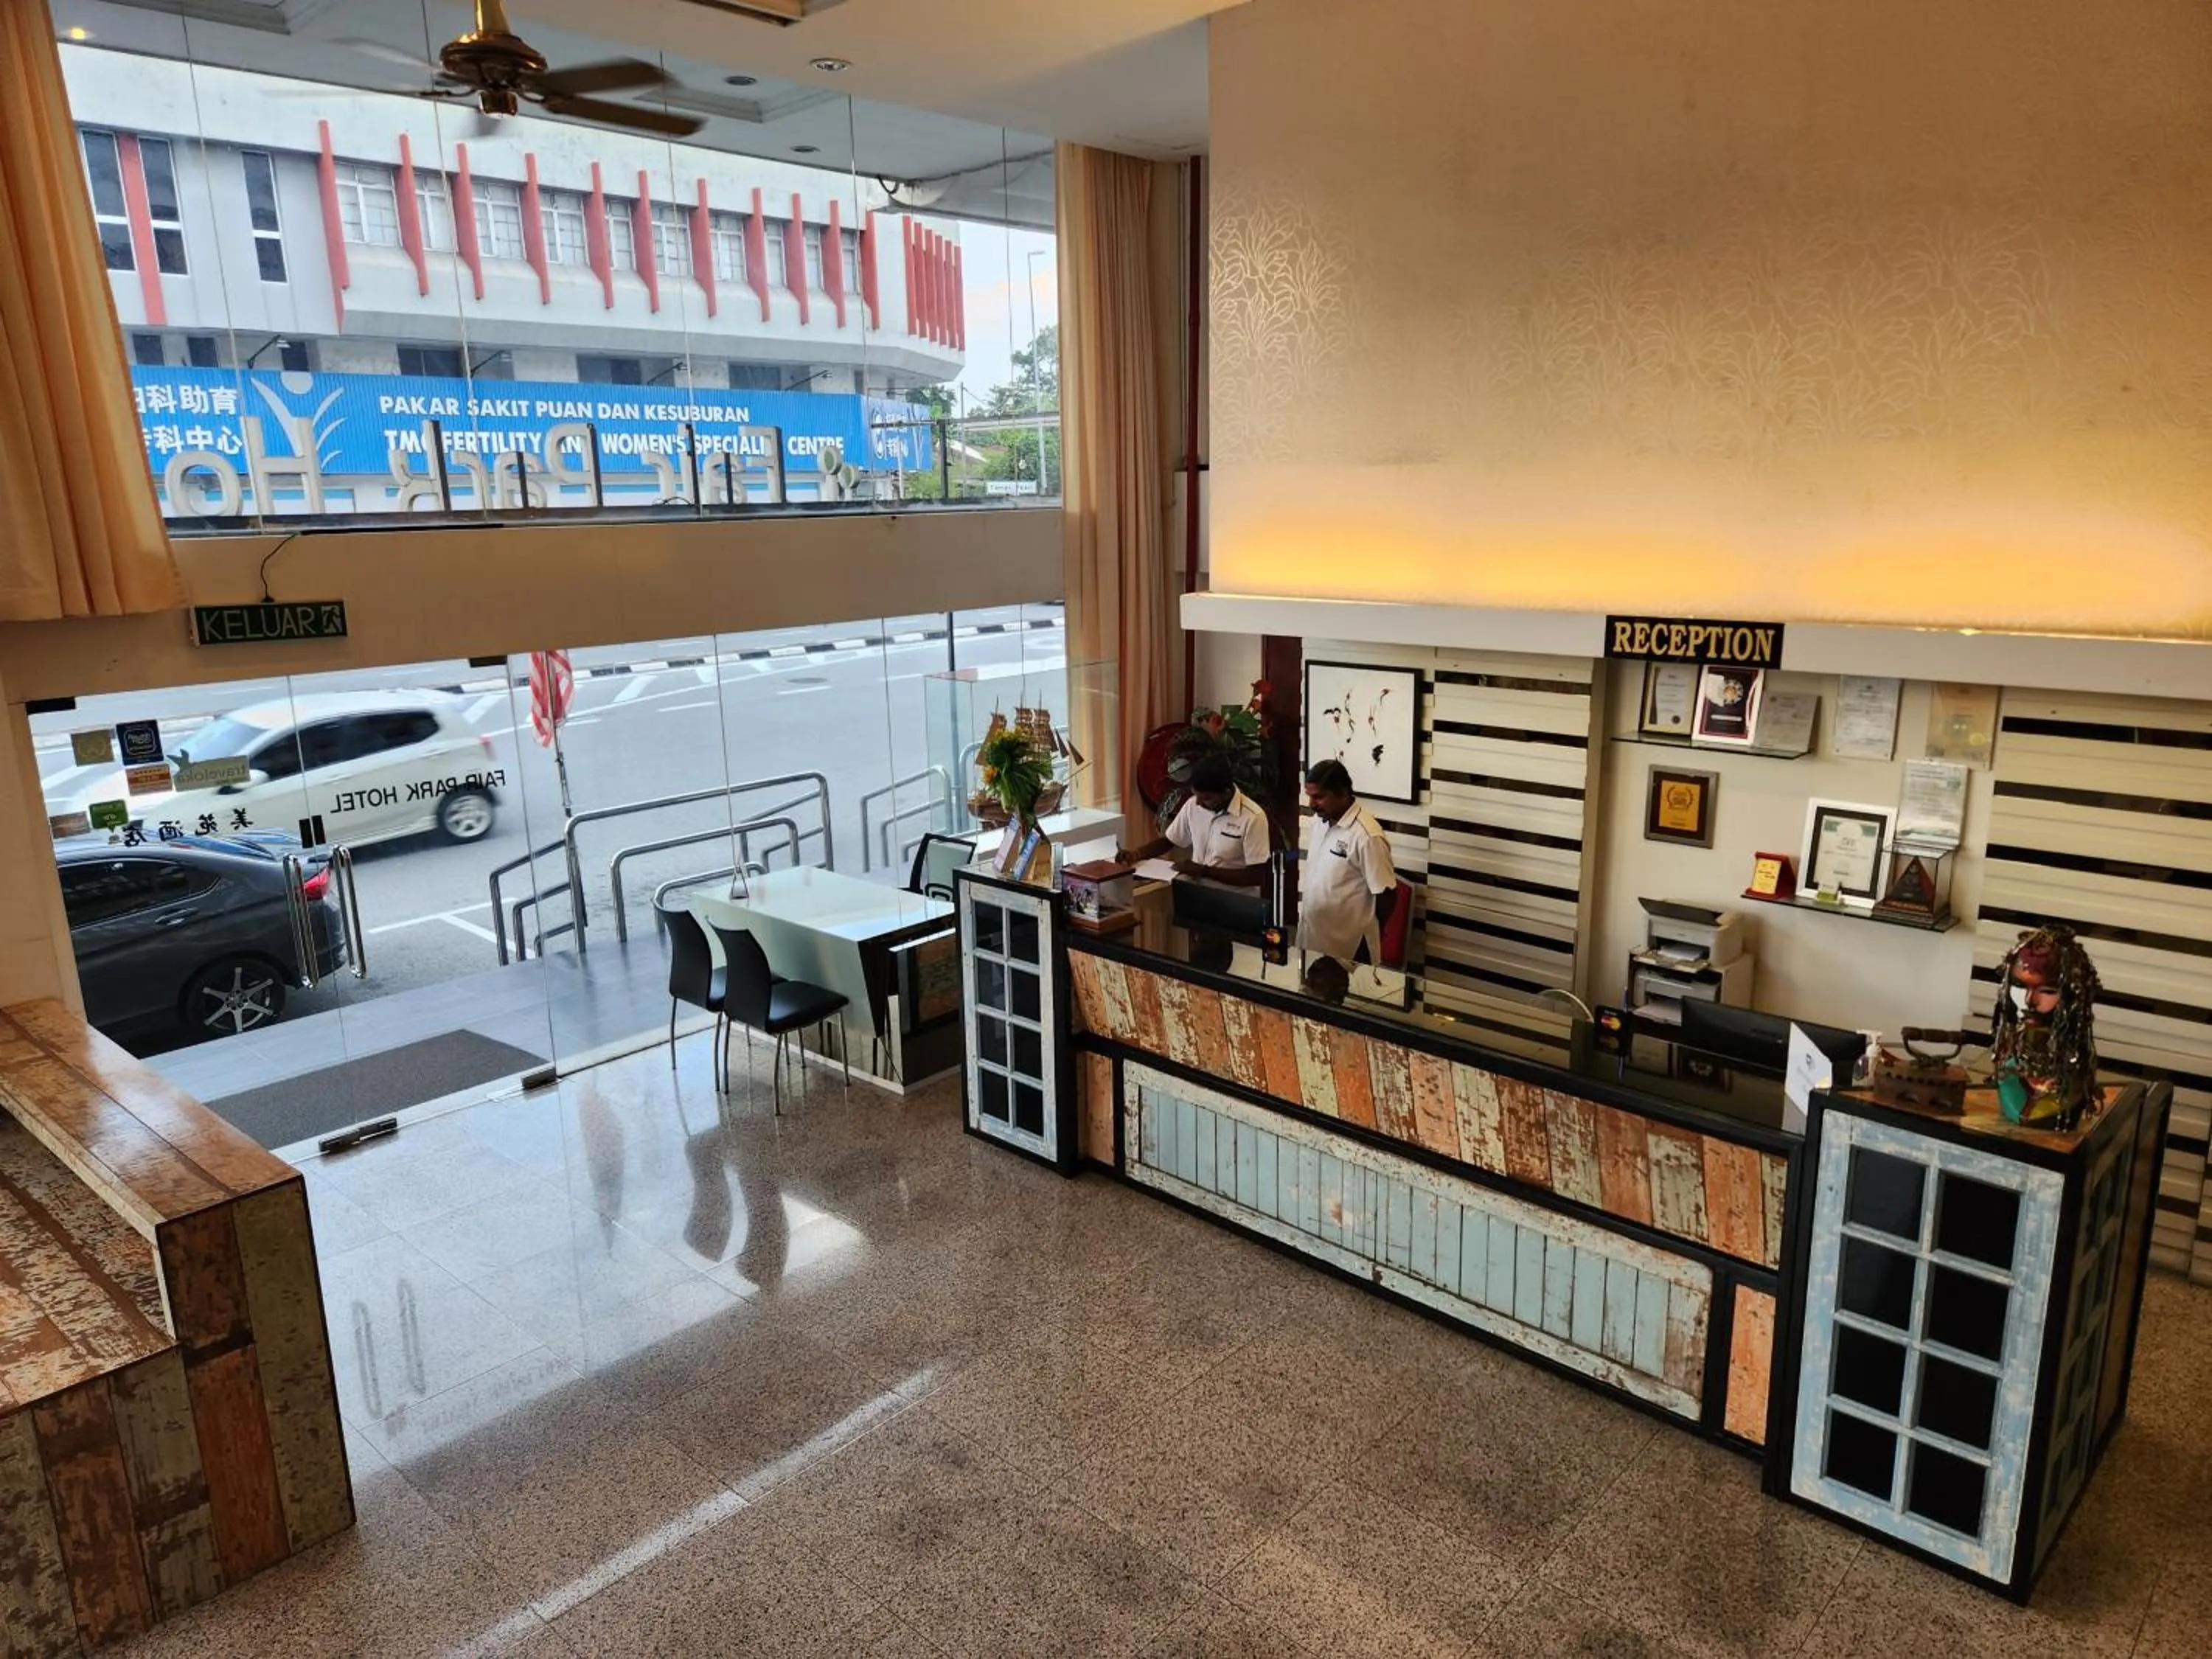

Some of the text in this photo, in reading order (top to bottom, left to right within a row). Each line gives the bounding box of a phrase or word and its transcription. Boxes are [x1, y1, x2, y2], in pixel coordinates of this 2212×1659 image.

[380, 395, 749, 422] PAKAR SAKIT PUAN DAN KESUBURAN
[442, 431, 542, 454] FERTILITY
[601, 433, 686, 455] WOMEN'S
[694, 434, 779, 455] SPECIALI
[202, 607, 316, 641] KELUAR
[1613, 622, 1775, 661] RECEPTION
